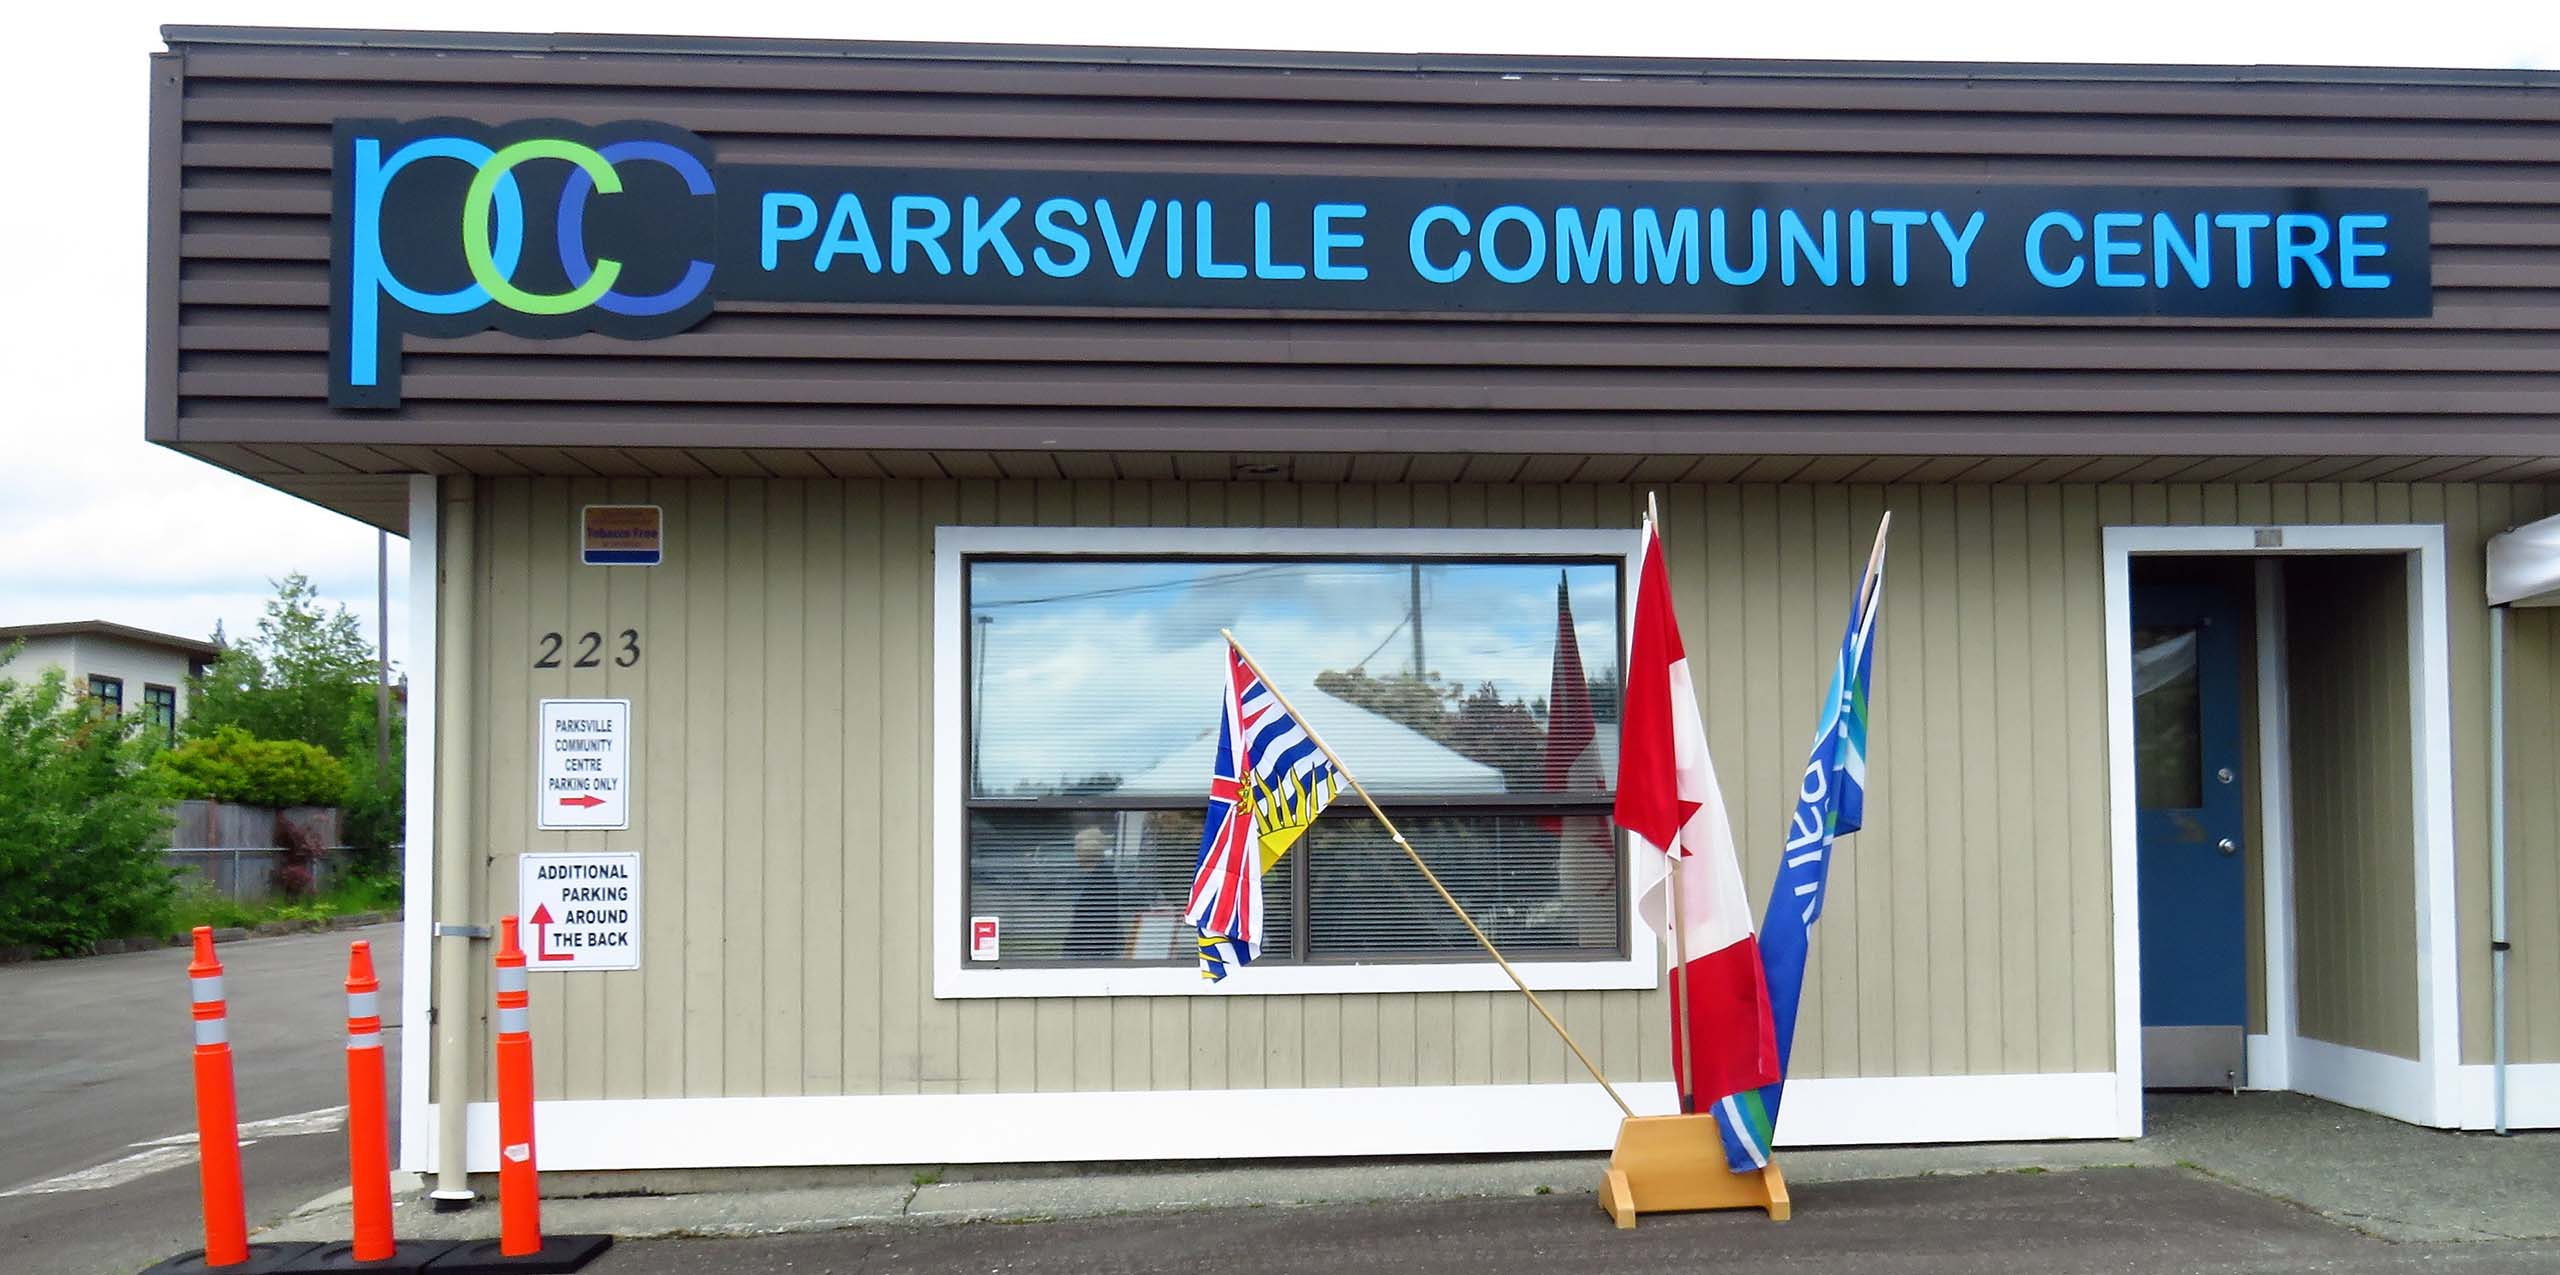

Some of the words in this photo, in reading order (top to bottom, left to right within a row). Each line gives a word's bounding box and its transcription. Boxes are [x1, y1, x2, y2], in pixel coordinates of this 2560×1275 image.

[760, 192, 1369, 281] PARKSVILLE
[1408, 204, 1985, 288] COMMUNITY
[2025, 211, 2391, 289] CENTRE
[632, 527, 657, 538] Free
[534, 629, 640, 669] 223
[555, 719, 612, 732] PARKSVILLE
[555, 739, 612, 752] COMMUNITY
[564, 758, 602, 771] CENTRE
[549, 777, 590, 791] PARKING
[593, 777, 617, 790] ONLY
[537, 864, 628, 880] ADDITIONAL
[562, 887, 628, 902] PARKING
[565, 909, 628, 924] AROUND
[553, 933, 583, 947] THE
[589, 931, 628, 947] BACK
